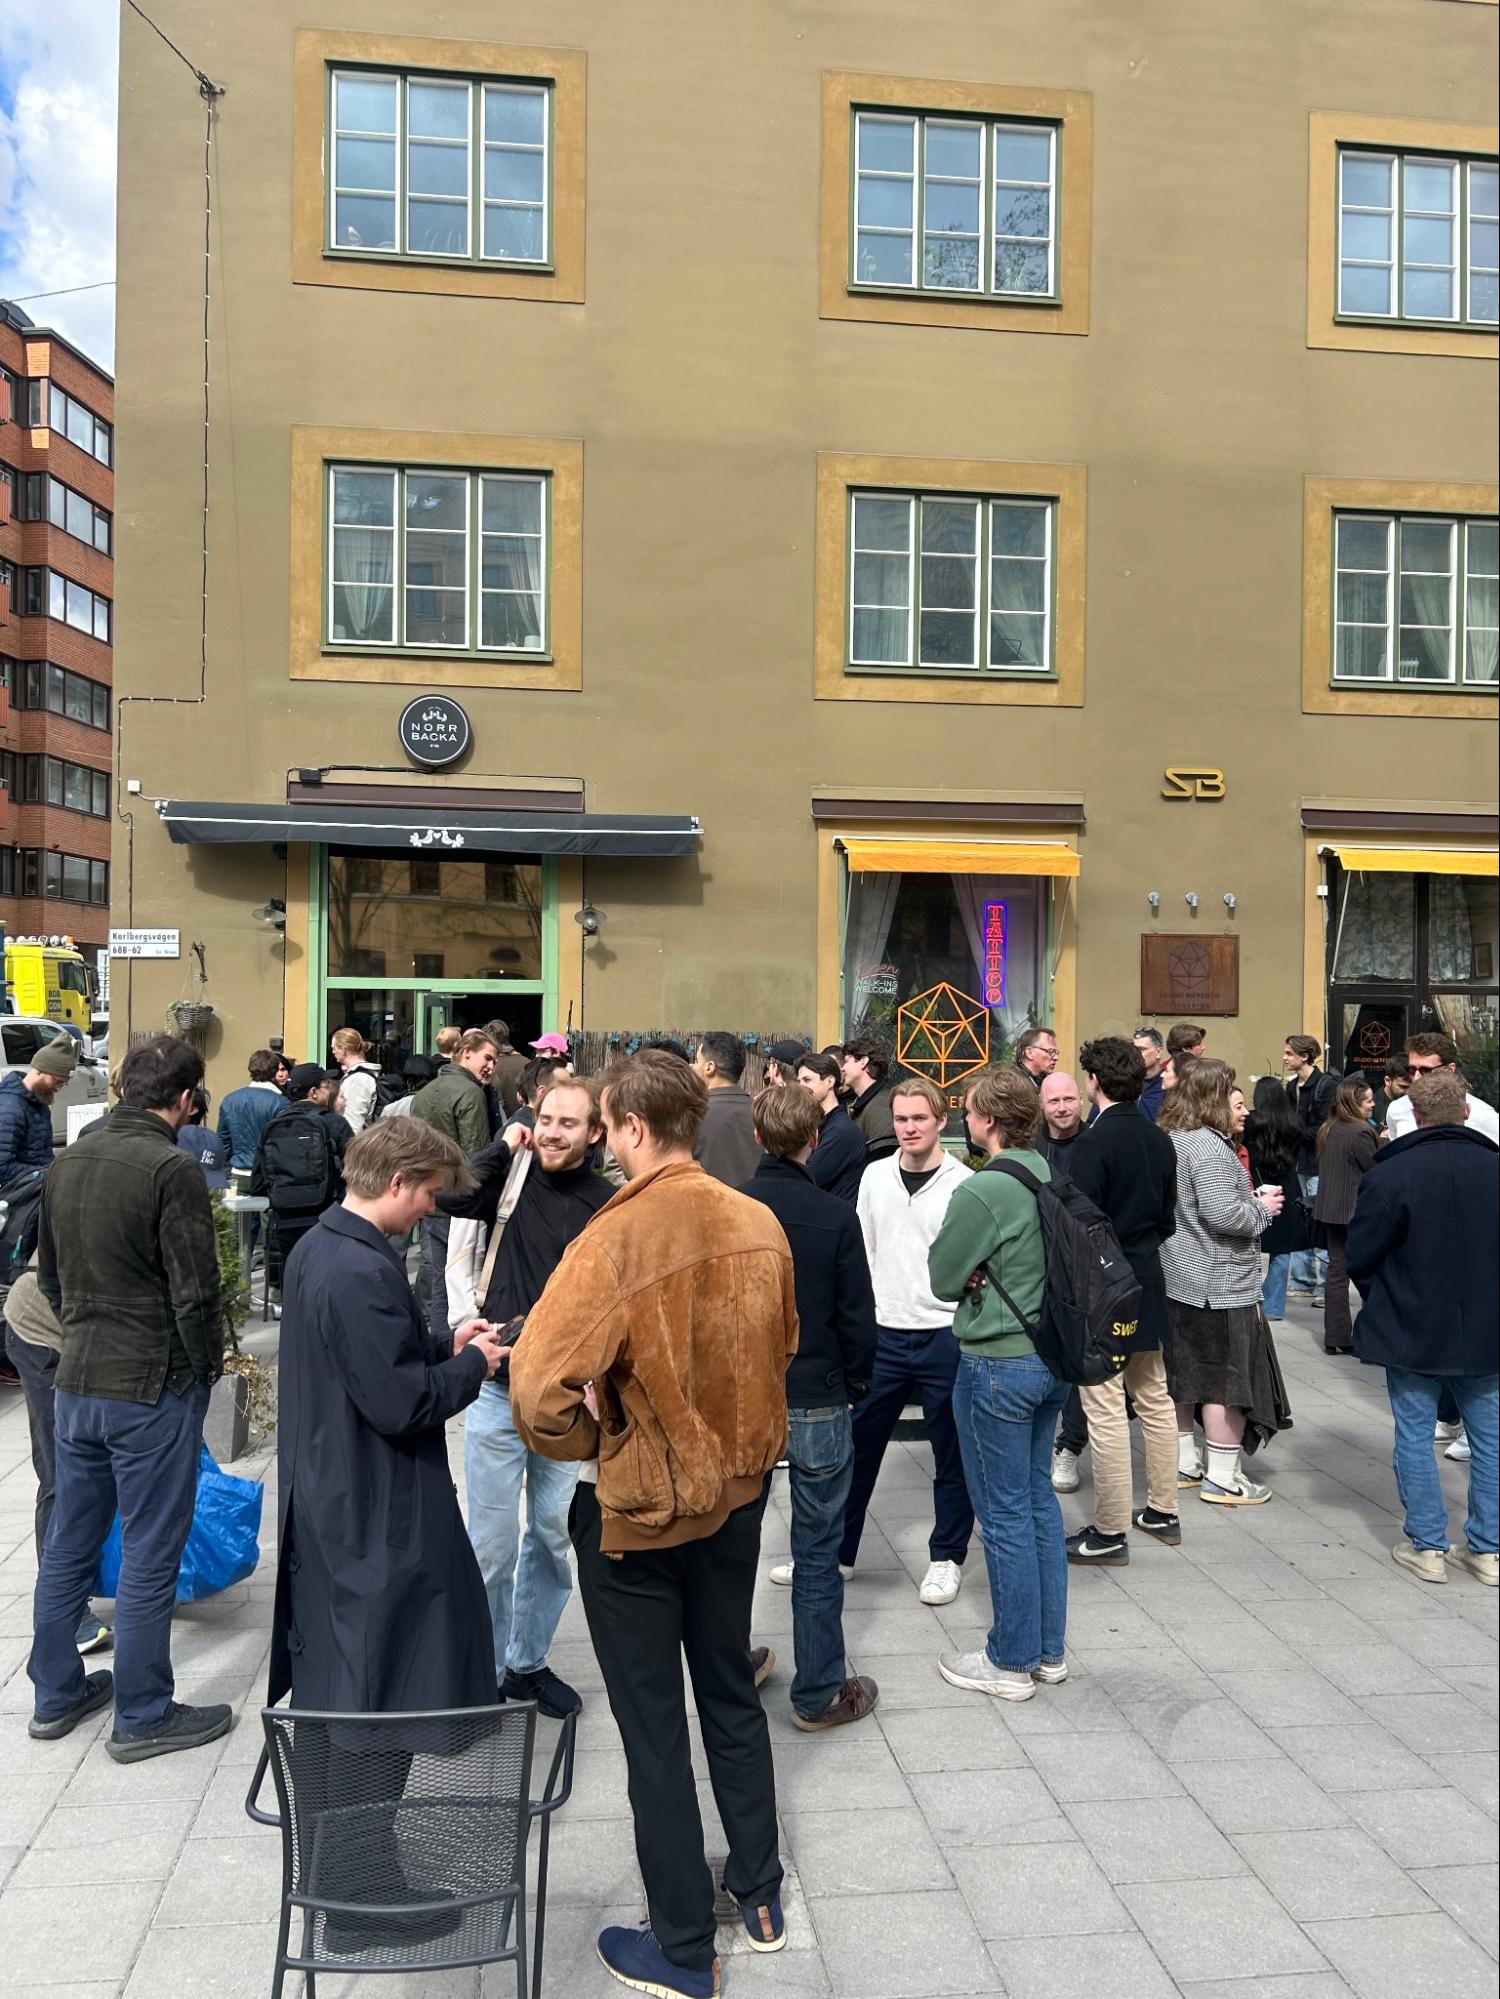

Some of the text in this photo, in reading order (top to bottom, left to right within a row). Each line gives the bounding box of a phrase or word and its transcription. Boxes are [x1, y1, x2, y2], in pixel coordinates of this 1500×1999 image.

[411, 722, 458, 733] NORR
[411, 732, 458, 742] BACKA
[985, 904, 1004, 1005] TATTOO
[856, 979, 898, 988] WALK-INS
[855, 986, 897, 995] WELCOME
